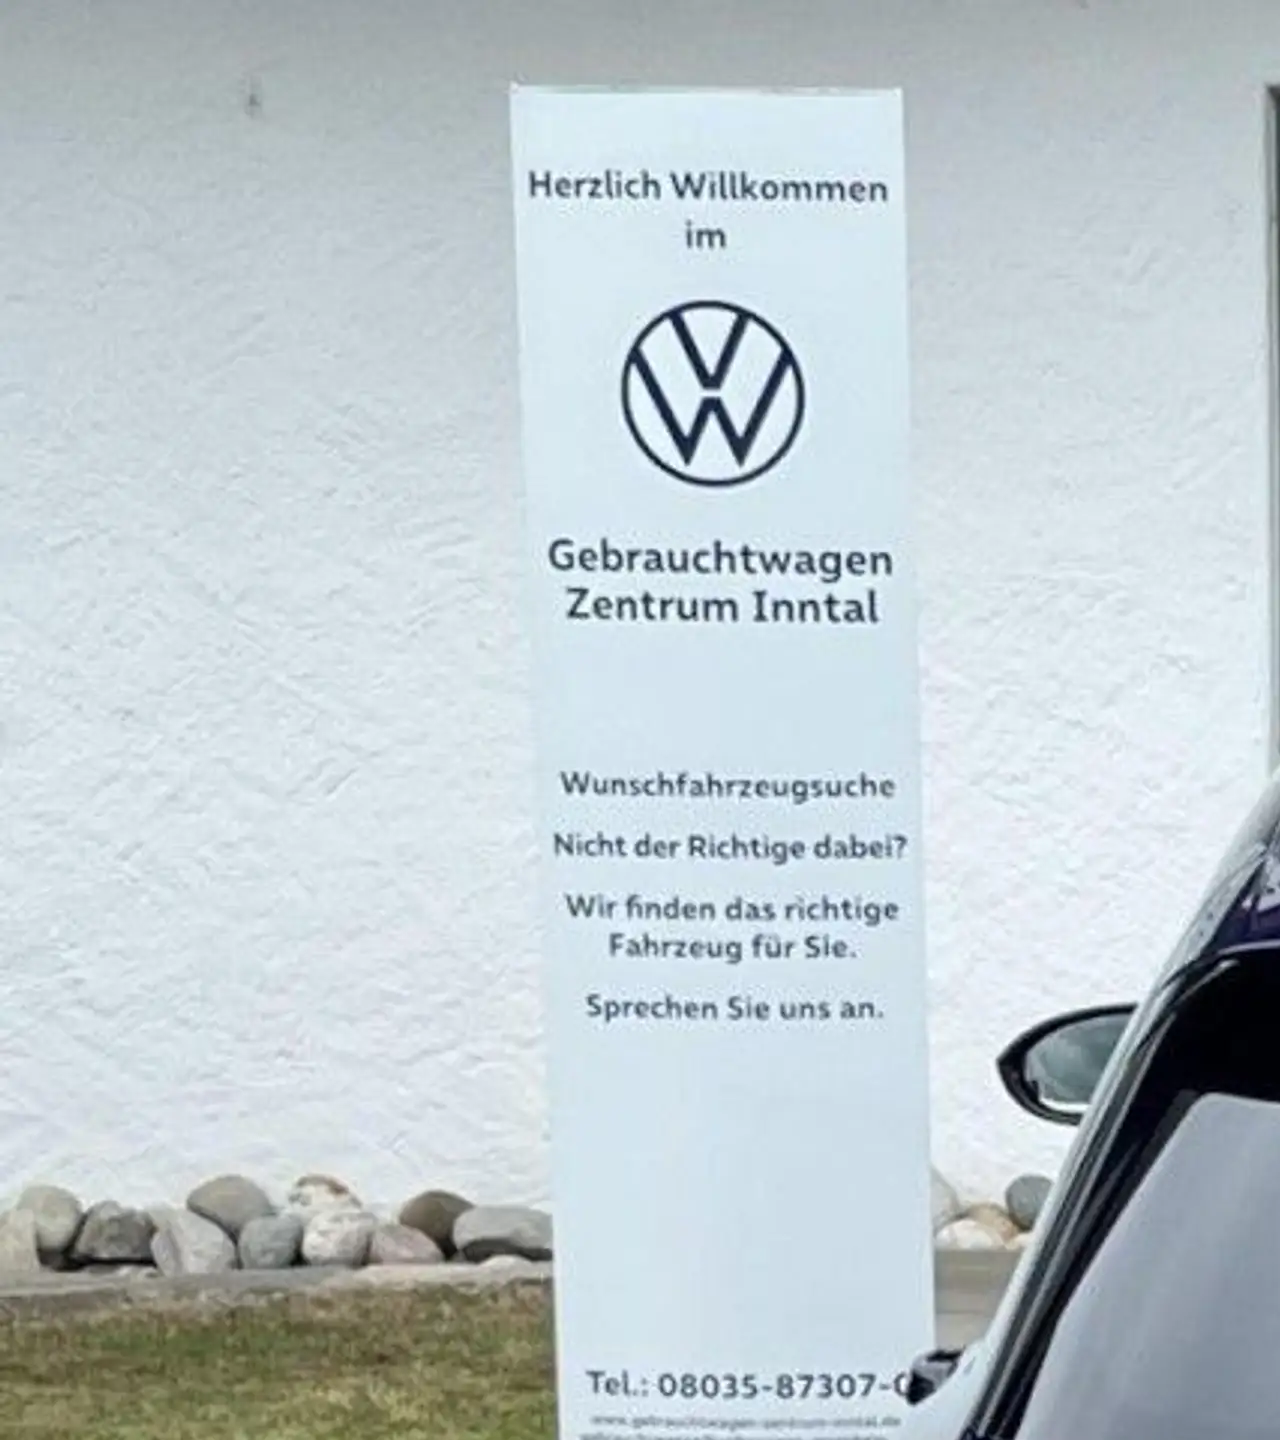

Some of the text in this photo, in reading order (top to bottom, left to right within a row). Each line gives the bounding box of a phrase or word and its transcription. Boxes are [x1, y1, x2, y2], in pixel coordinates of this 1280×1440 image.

[528, 168, 888, 204] Herzlich Willkommen
[685, 219, 727, 250] im
[547, 537, 893, 585] Gebrauchtwagen
[565, 586, 879, 624] Zentrum Inntal
[559, 770, 896, 806] Wunschfahrzeugsuche
[553, 831, 909, 867] Nicht der Richtige dabei?
[563, 893, 900, 927] Wir finden das richtige
[608, 932, 857, 966] Fahrzeug für Sie.
[585, 993, 884, 1024] Sprechen Sie uns an.
[587, 1371, 650, 1397] Tel.:
